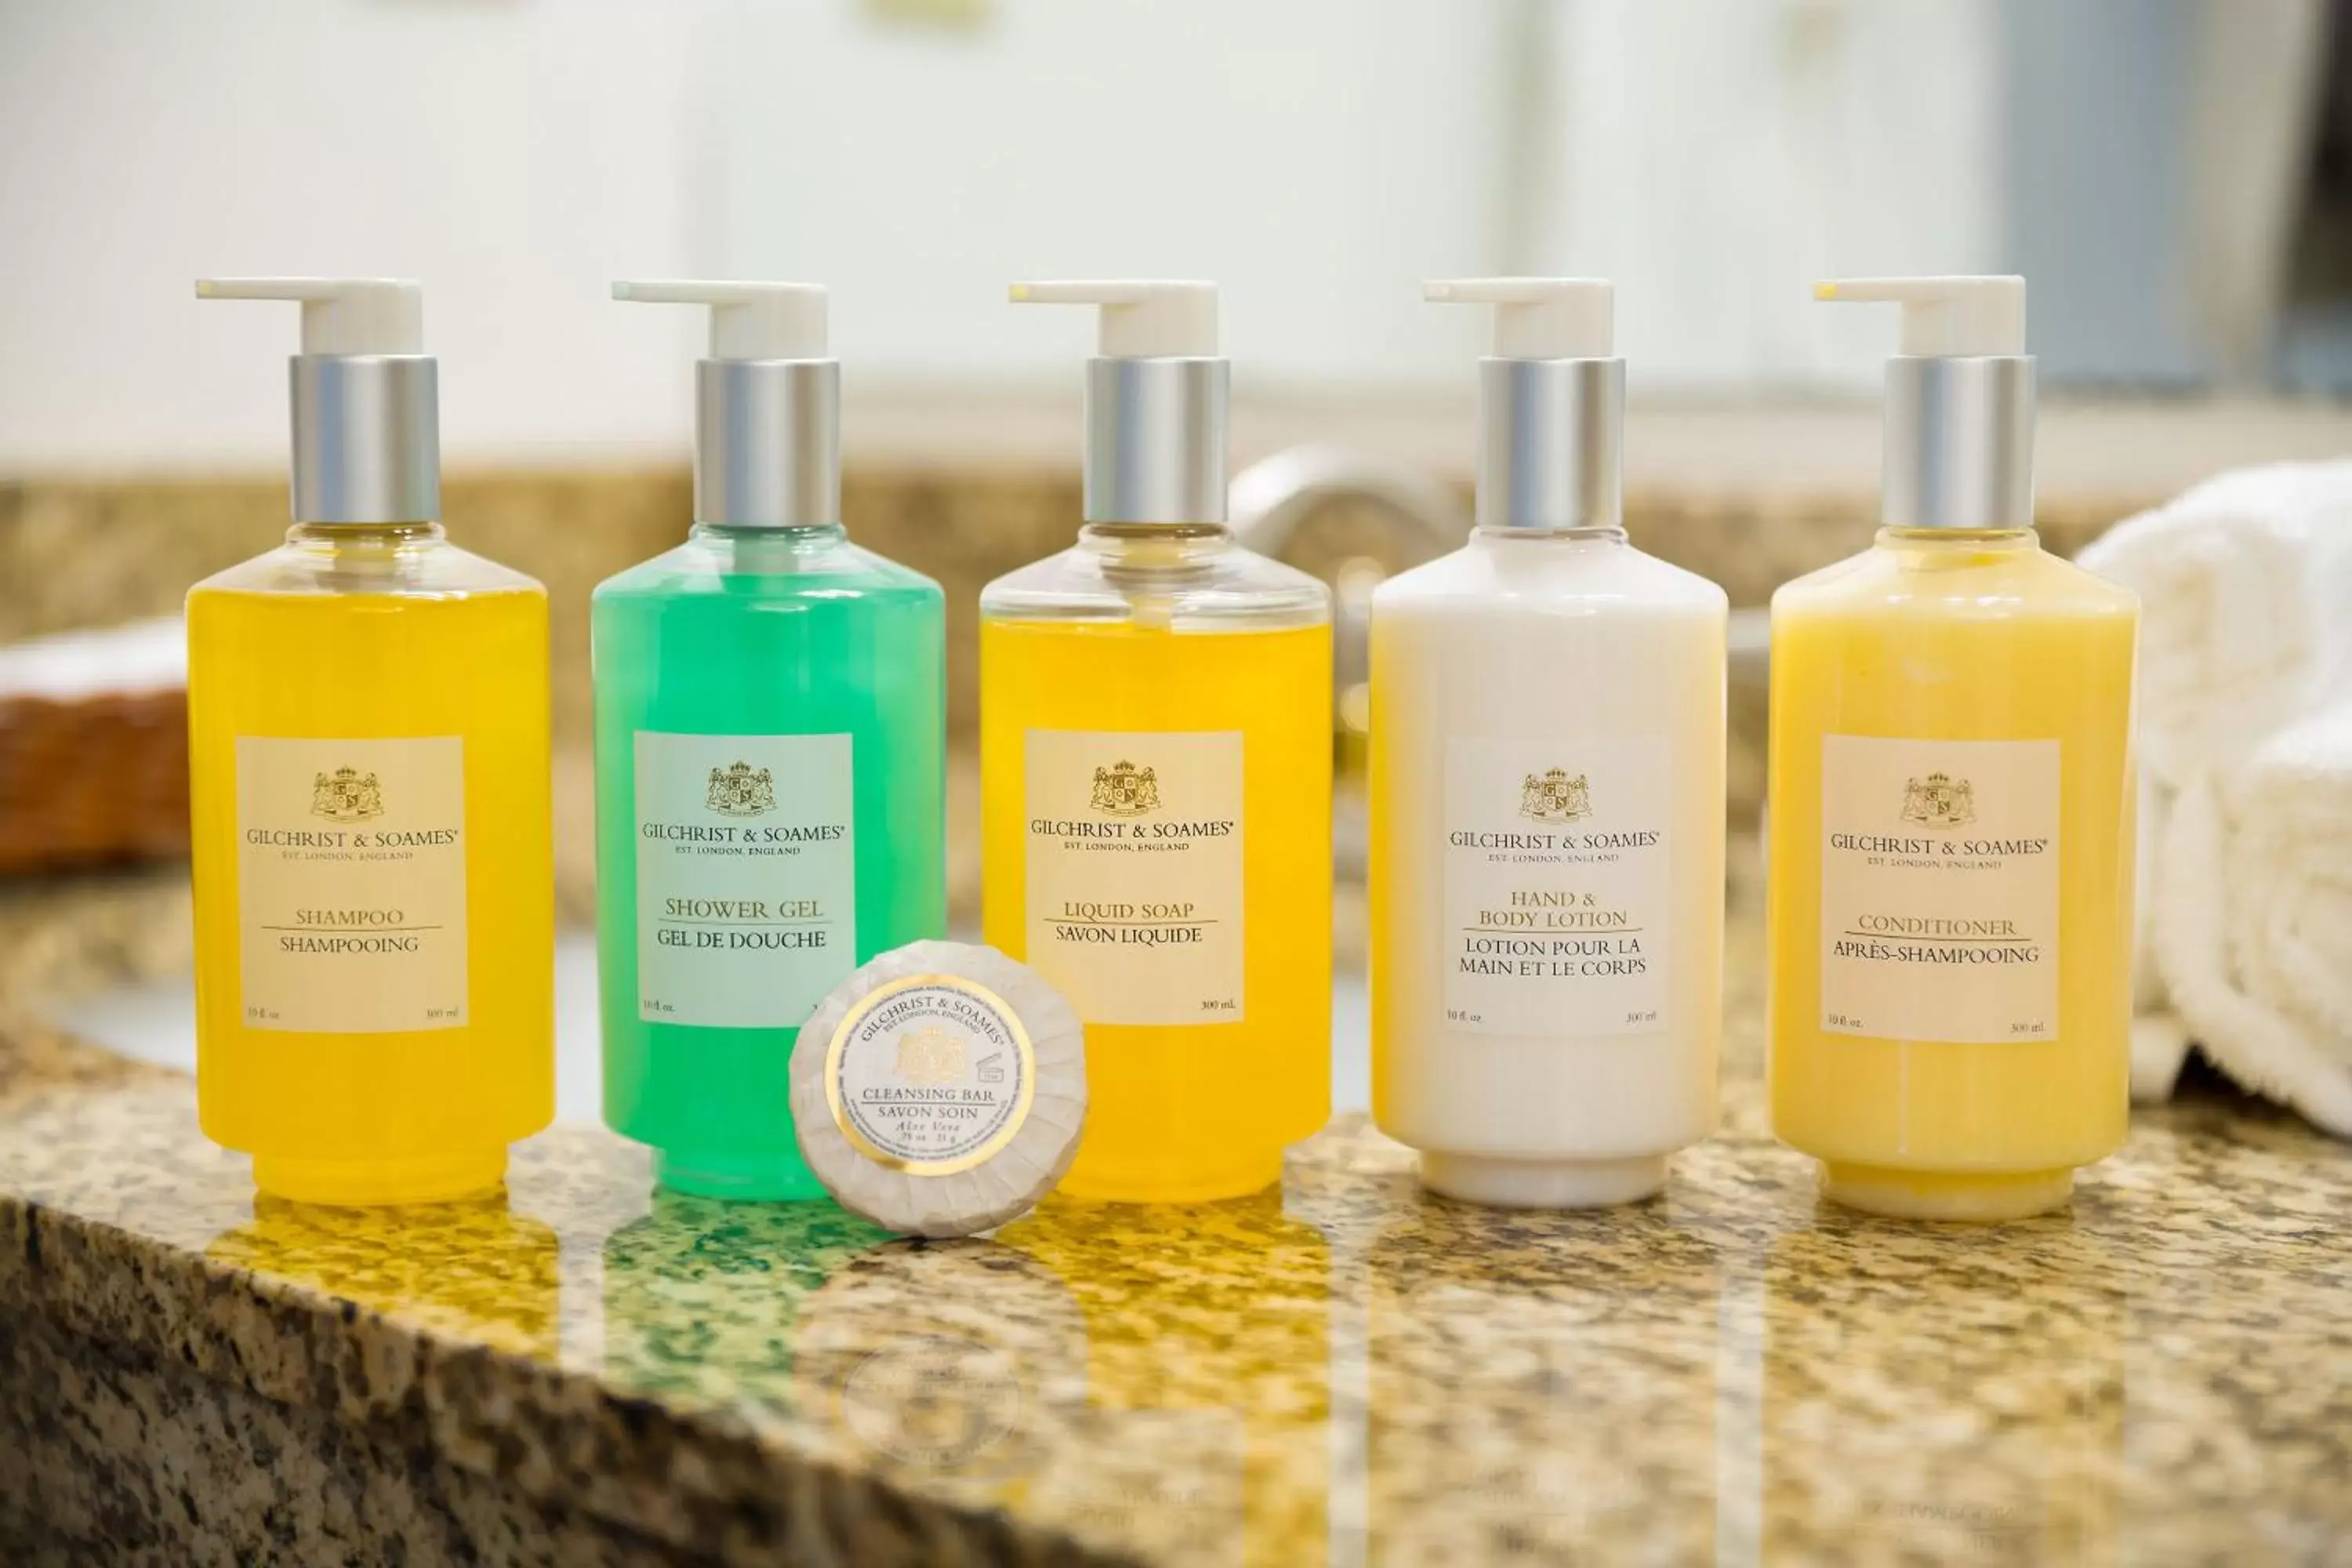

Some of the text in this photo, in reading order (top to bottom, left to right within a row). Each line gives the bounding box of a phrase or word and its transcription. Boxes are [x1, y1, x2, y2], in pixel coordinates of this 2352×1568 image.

[247, 829, 347, 848] GILCHRIST
[354, 836, 370, 848] &
[642, 823, 738, 843] GILCHRIST
[743, 830, 757, 843] &
[1031, 819, 1127, 839] GILCHRIST
[1133, 826, 1147, 838] &
[1138, 842, 1189, 852] ENGLAND
[1450, 831, 1556, 850] GILCHRIST
[1563, 837, 1577, 850] &
[1831, 833, 1936, 855] GILCHRIST
[1942, 842, 1957, 855] &
[749, 847, 800, 855] ENGLAND
[1947, 860, 2002, 870] ENGLAND
[666, 898, 825, 919] SHOWER GEL
[1512, 891, 1596, 907] HAND &
[296, 909, 404, 926] SHAMPOO
[1065, 902, 1195, 922] LIQUID SOAP
[1480, 910, 1628, 927] BODY LOTION
[1858, 913, 2017, 936] CONDITIONER
[280, 937, 419, 954] SHAMPOOING
[657, 928, 827, 949] GEL DE DOUCHE
[1055, 925, 1203, 947] SAVON LIQUIDE
[1466, 937, 1641, 956] LOTION POUR LA
[1833, 939, 2039, 964] APRÈS-SHAMPOOING
[1459, 956, 1646, 977] MAIN ET LE CORPS
[862, 996, 934, 1042] GILCHRIST
[938, 997, 949, 1008] &
[863, 1087, 995, 1102] CLEANSING BAR
[878, 1105, 978, 1119] SAVON SOIN
